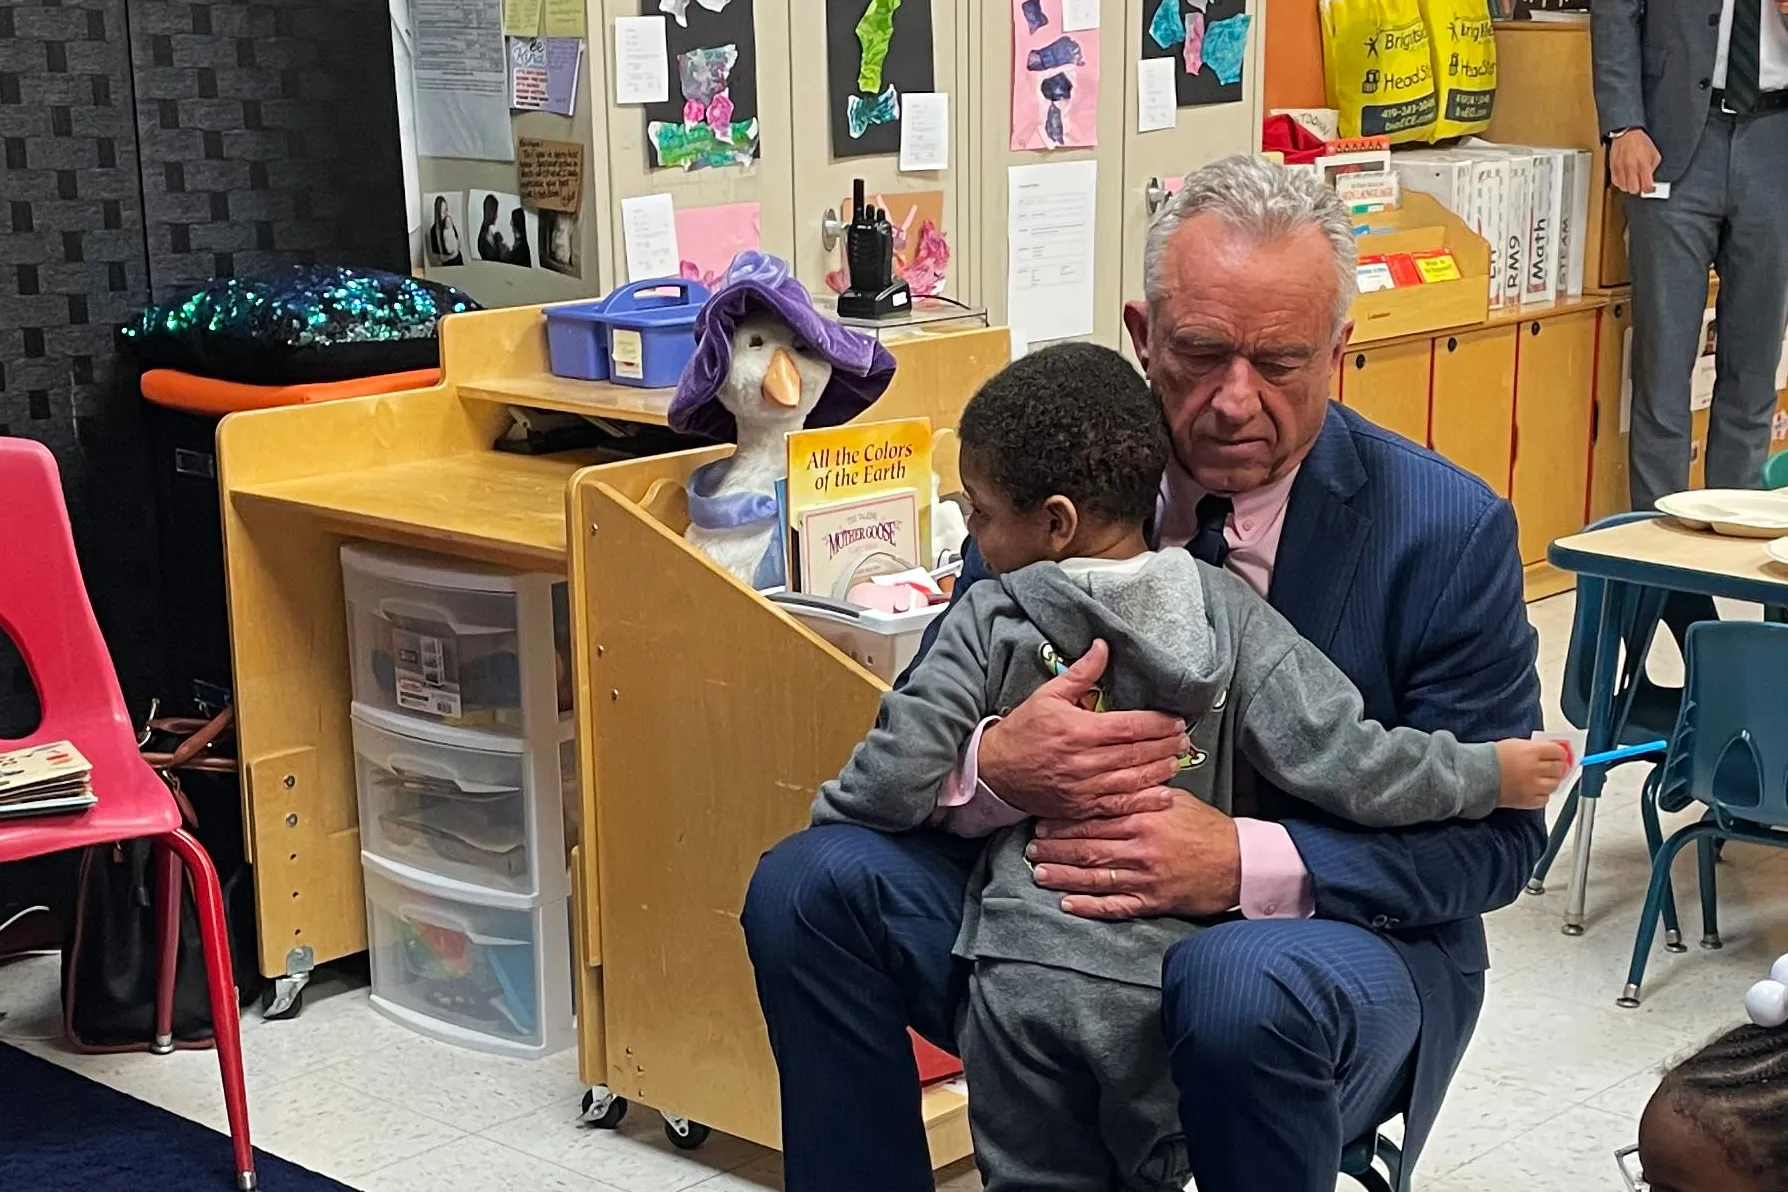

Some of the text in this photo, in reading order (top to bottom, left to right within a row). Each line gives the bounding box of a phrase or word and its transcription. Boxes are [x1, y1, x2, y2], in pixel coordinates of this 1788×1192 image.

[1532, 218, 1546, 280] Math
[806, 441, 913, 471] All the Colors
[814, 460, 906, 495] of the Earth
[827, 520, 897, 561] MOTHER GOOSE
